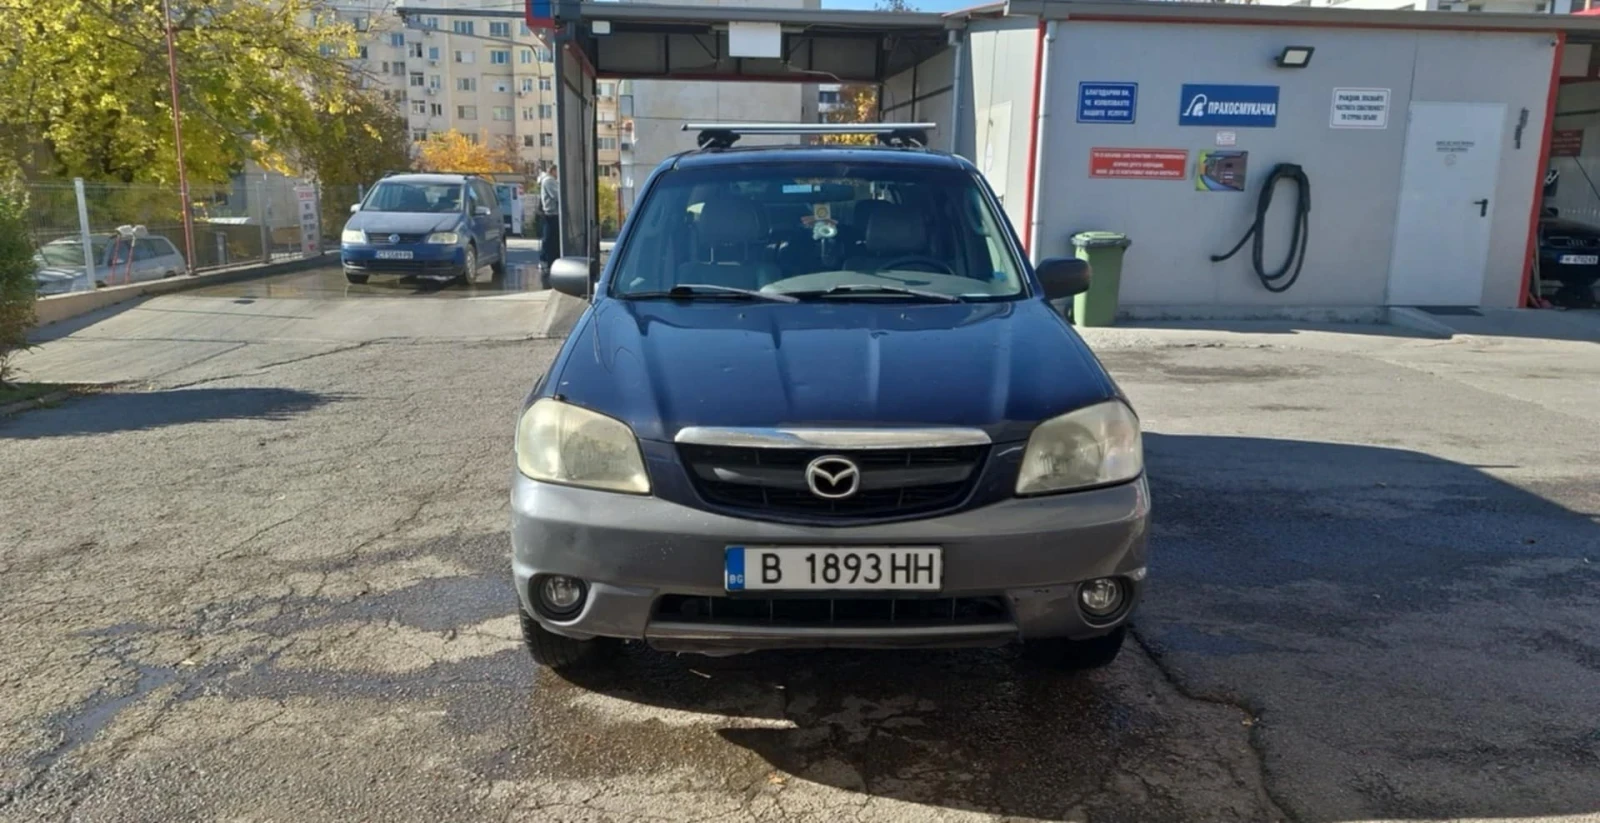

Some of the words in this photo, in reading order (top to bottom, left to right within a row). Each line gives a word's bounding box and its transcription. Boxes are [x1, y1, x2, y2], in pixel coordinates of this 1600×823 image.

[1207, 101, 1276, 115] ПРАХОСМУКАЧКА
[761, 553, 782, 584] B
[729, 574, 744, 584] BG
